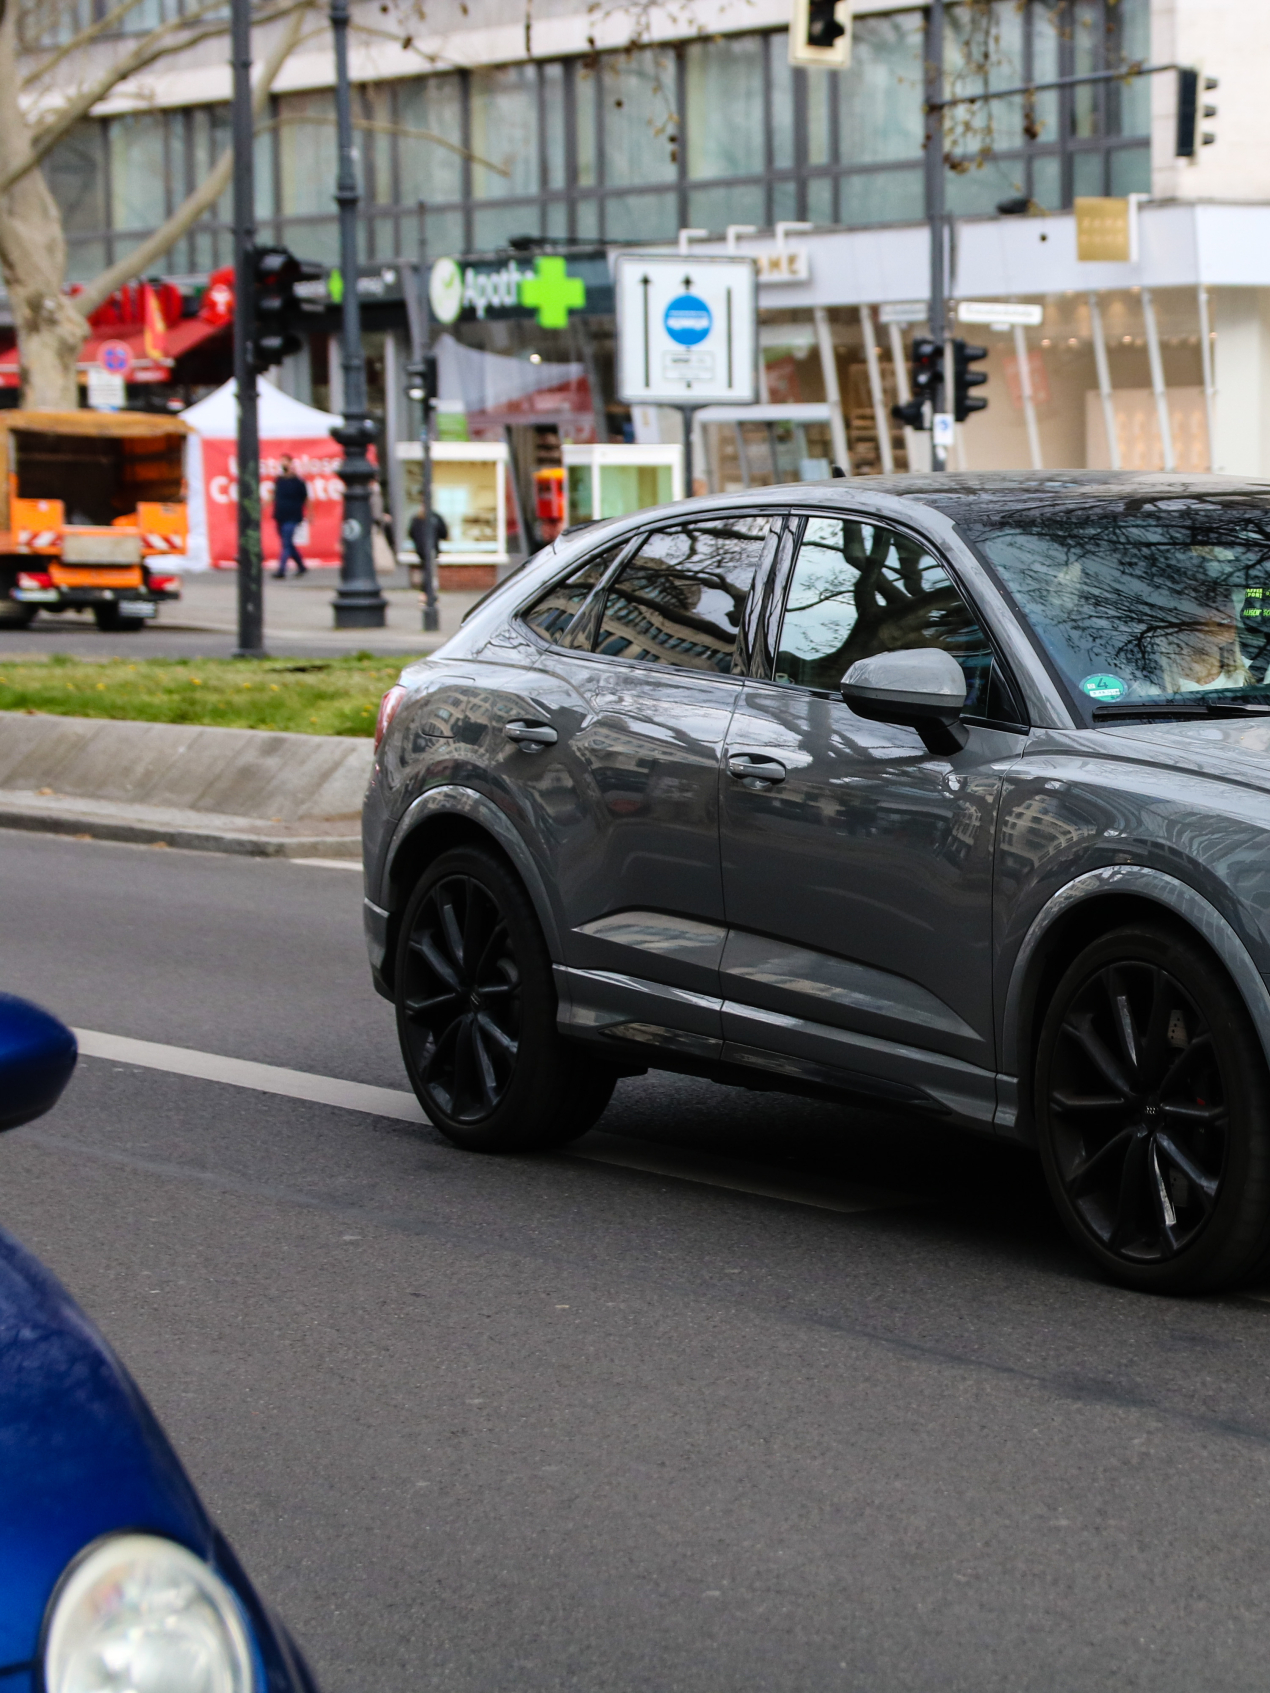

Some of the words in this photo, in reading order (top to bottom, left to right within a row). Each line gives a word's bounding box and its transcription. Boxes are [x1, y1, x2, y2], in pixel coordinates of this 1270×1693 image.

[757, 255, 800, 275] ME
[463, 259, 535, 319] Apoth
[1097, 677, 1108, 689] 4
